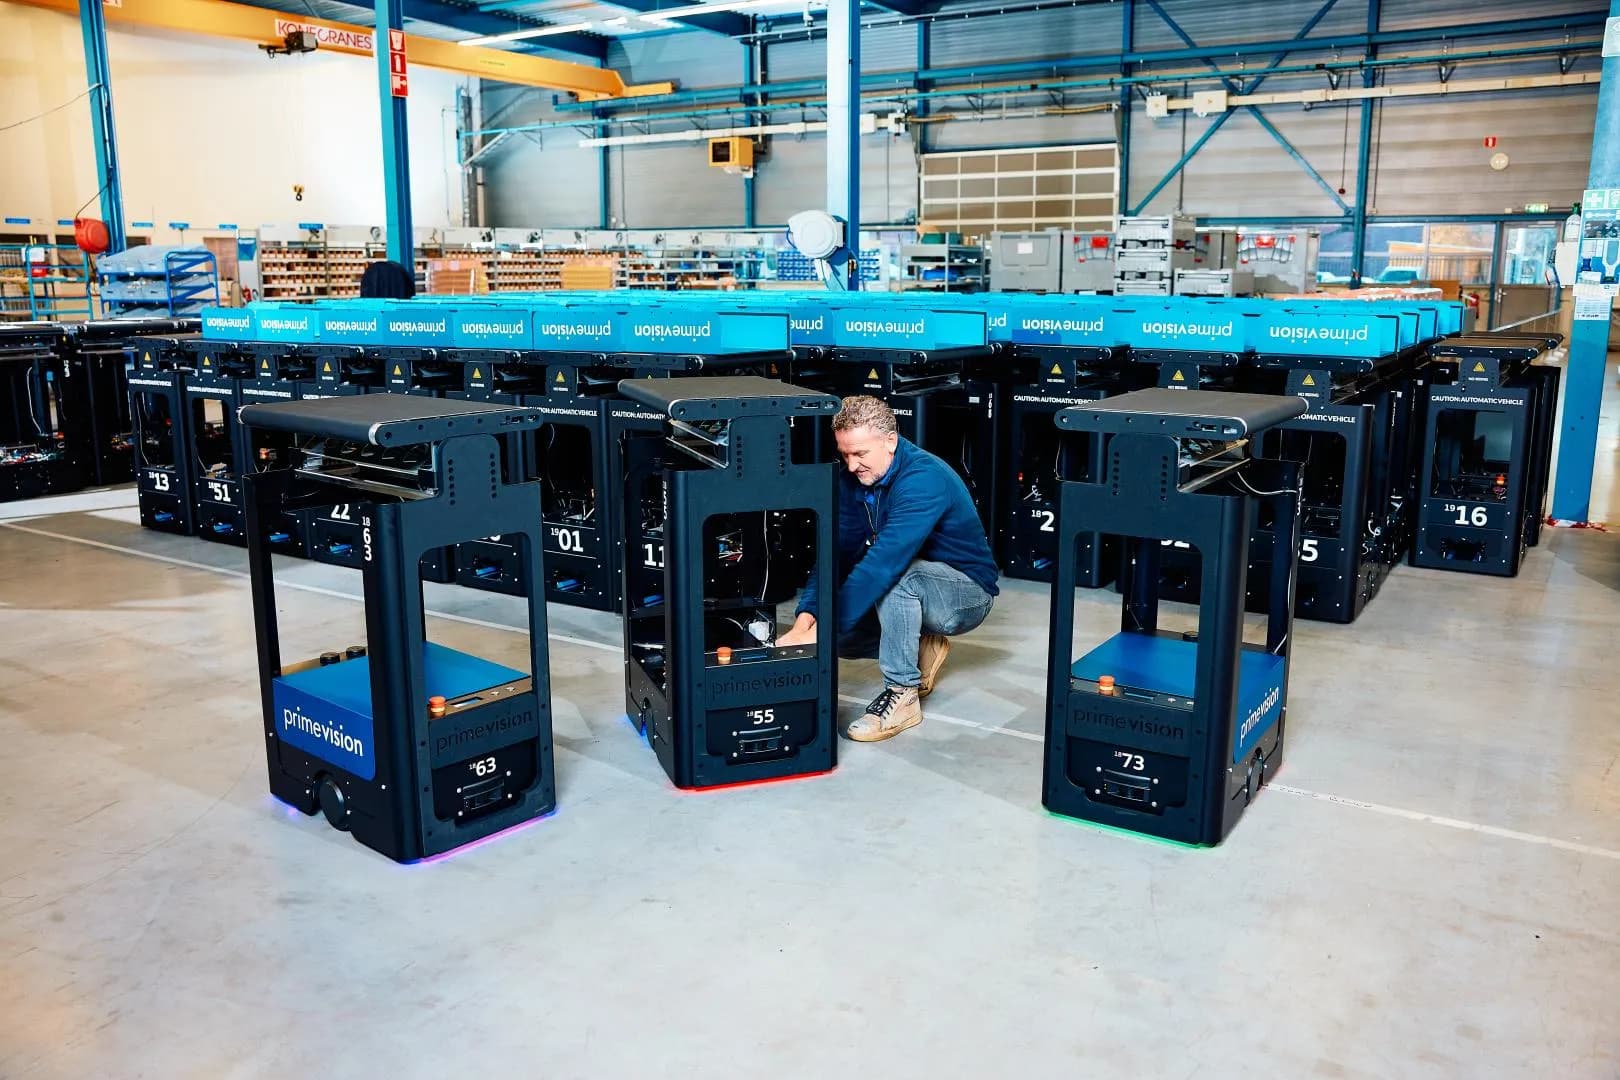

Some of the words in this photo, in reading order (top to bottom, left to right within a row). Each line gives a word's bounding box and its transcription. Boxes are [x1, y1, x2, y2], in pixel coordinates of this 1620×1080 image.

[261, 316, 308, 334] primevision
[325, 318, 377, 335] primevision
[389, 318, 445, 336] primevision
[462, 320, 524, 338] primevision
[542, 320, 611, 341] primevision
[634, 321, 711, 342] primevision
[845, 319, 925, 338] primevision
[1022, 316, 1104, 336] primevision
[1142, 321, 1233, 340] primevision
[1269, 324, 1369, 345] primevision
[713, 670, 812, 700] primevision
[1240, 686, 1279, 748] primevision
[284, 706, 363, 757] primevision
[437, 710, 532, 756] primevision
